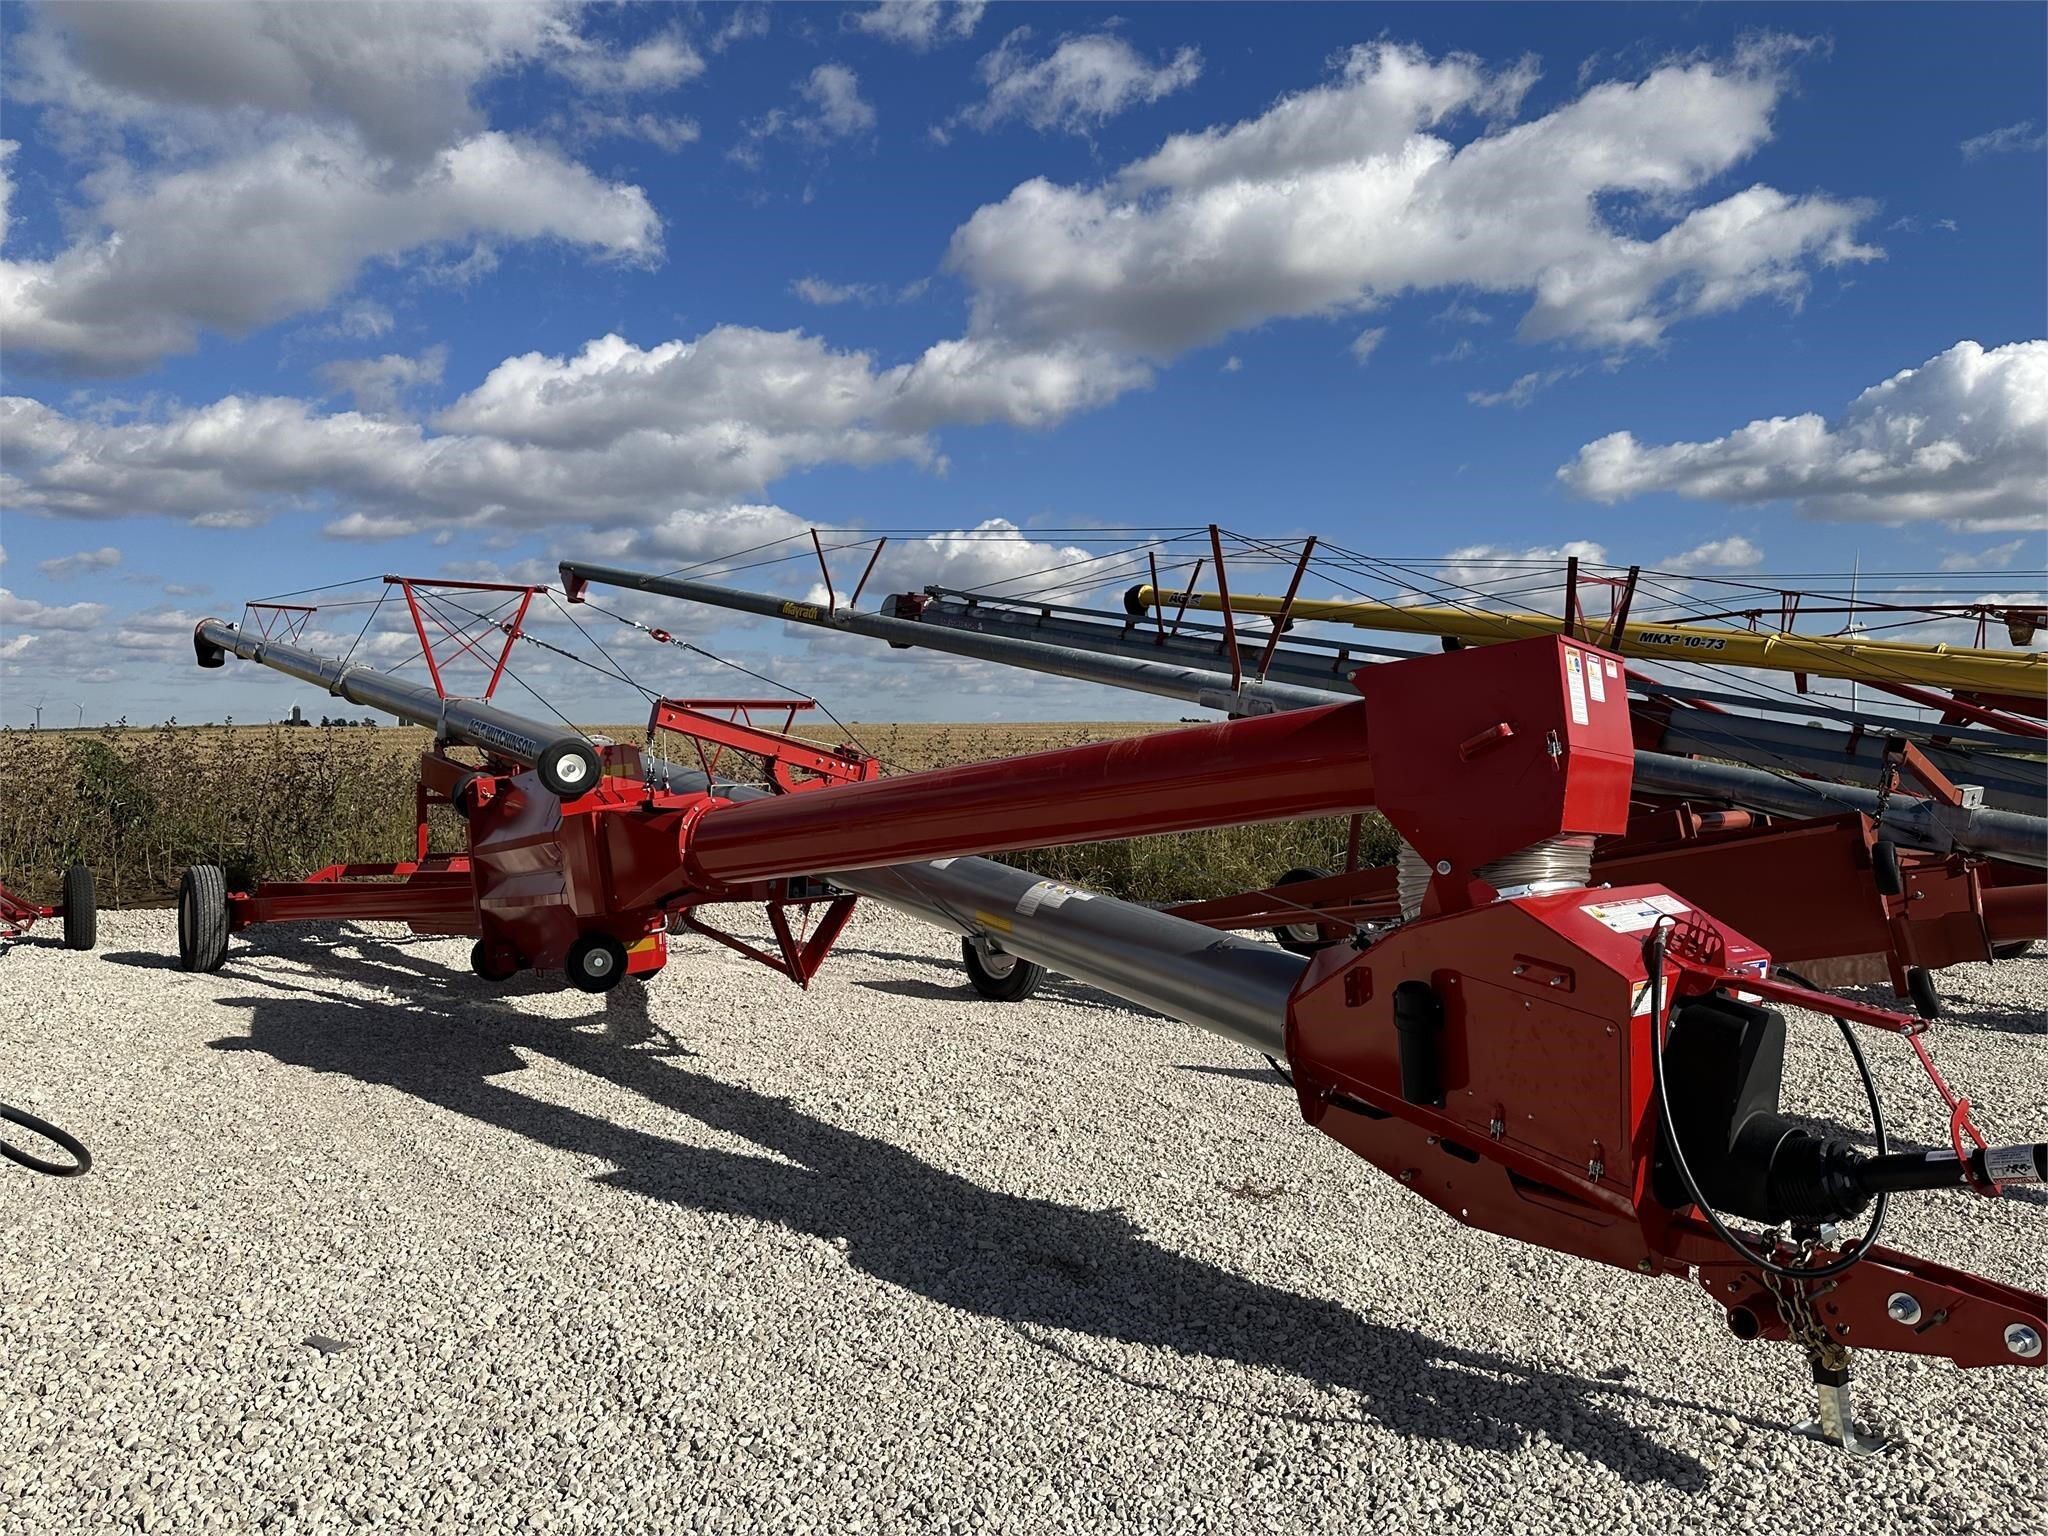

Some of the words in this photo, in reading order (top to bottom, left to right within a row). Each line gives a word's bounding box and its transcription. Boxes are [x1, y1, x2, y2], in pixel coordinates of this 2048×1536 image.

[782, 602, 818, 620] Mayrath
[1684, 636, 1726, 650] 10-73
[485, 724, 536, 759] HUTCHINSON
